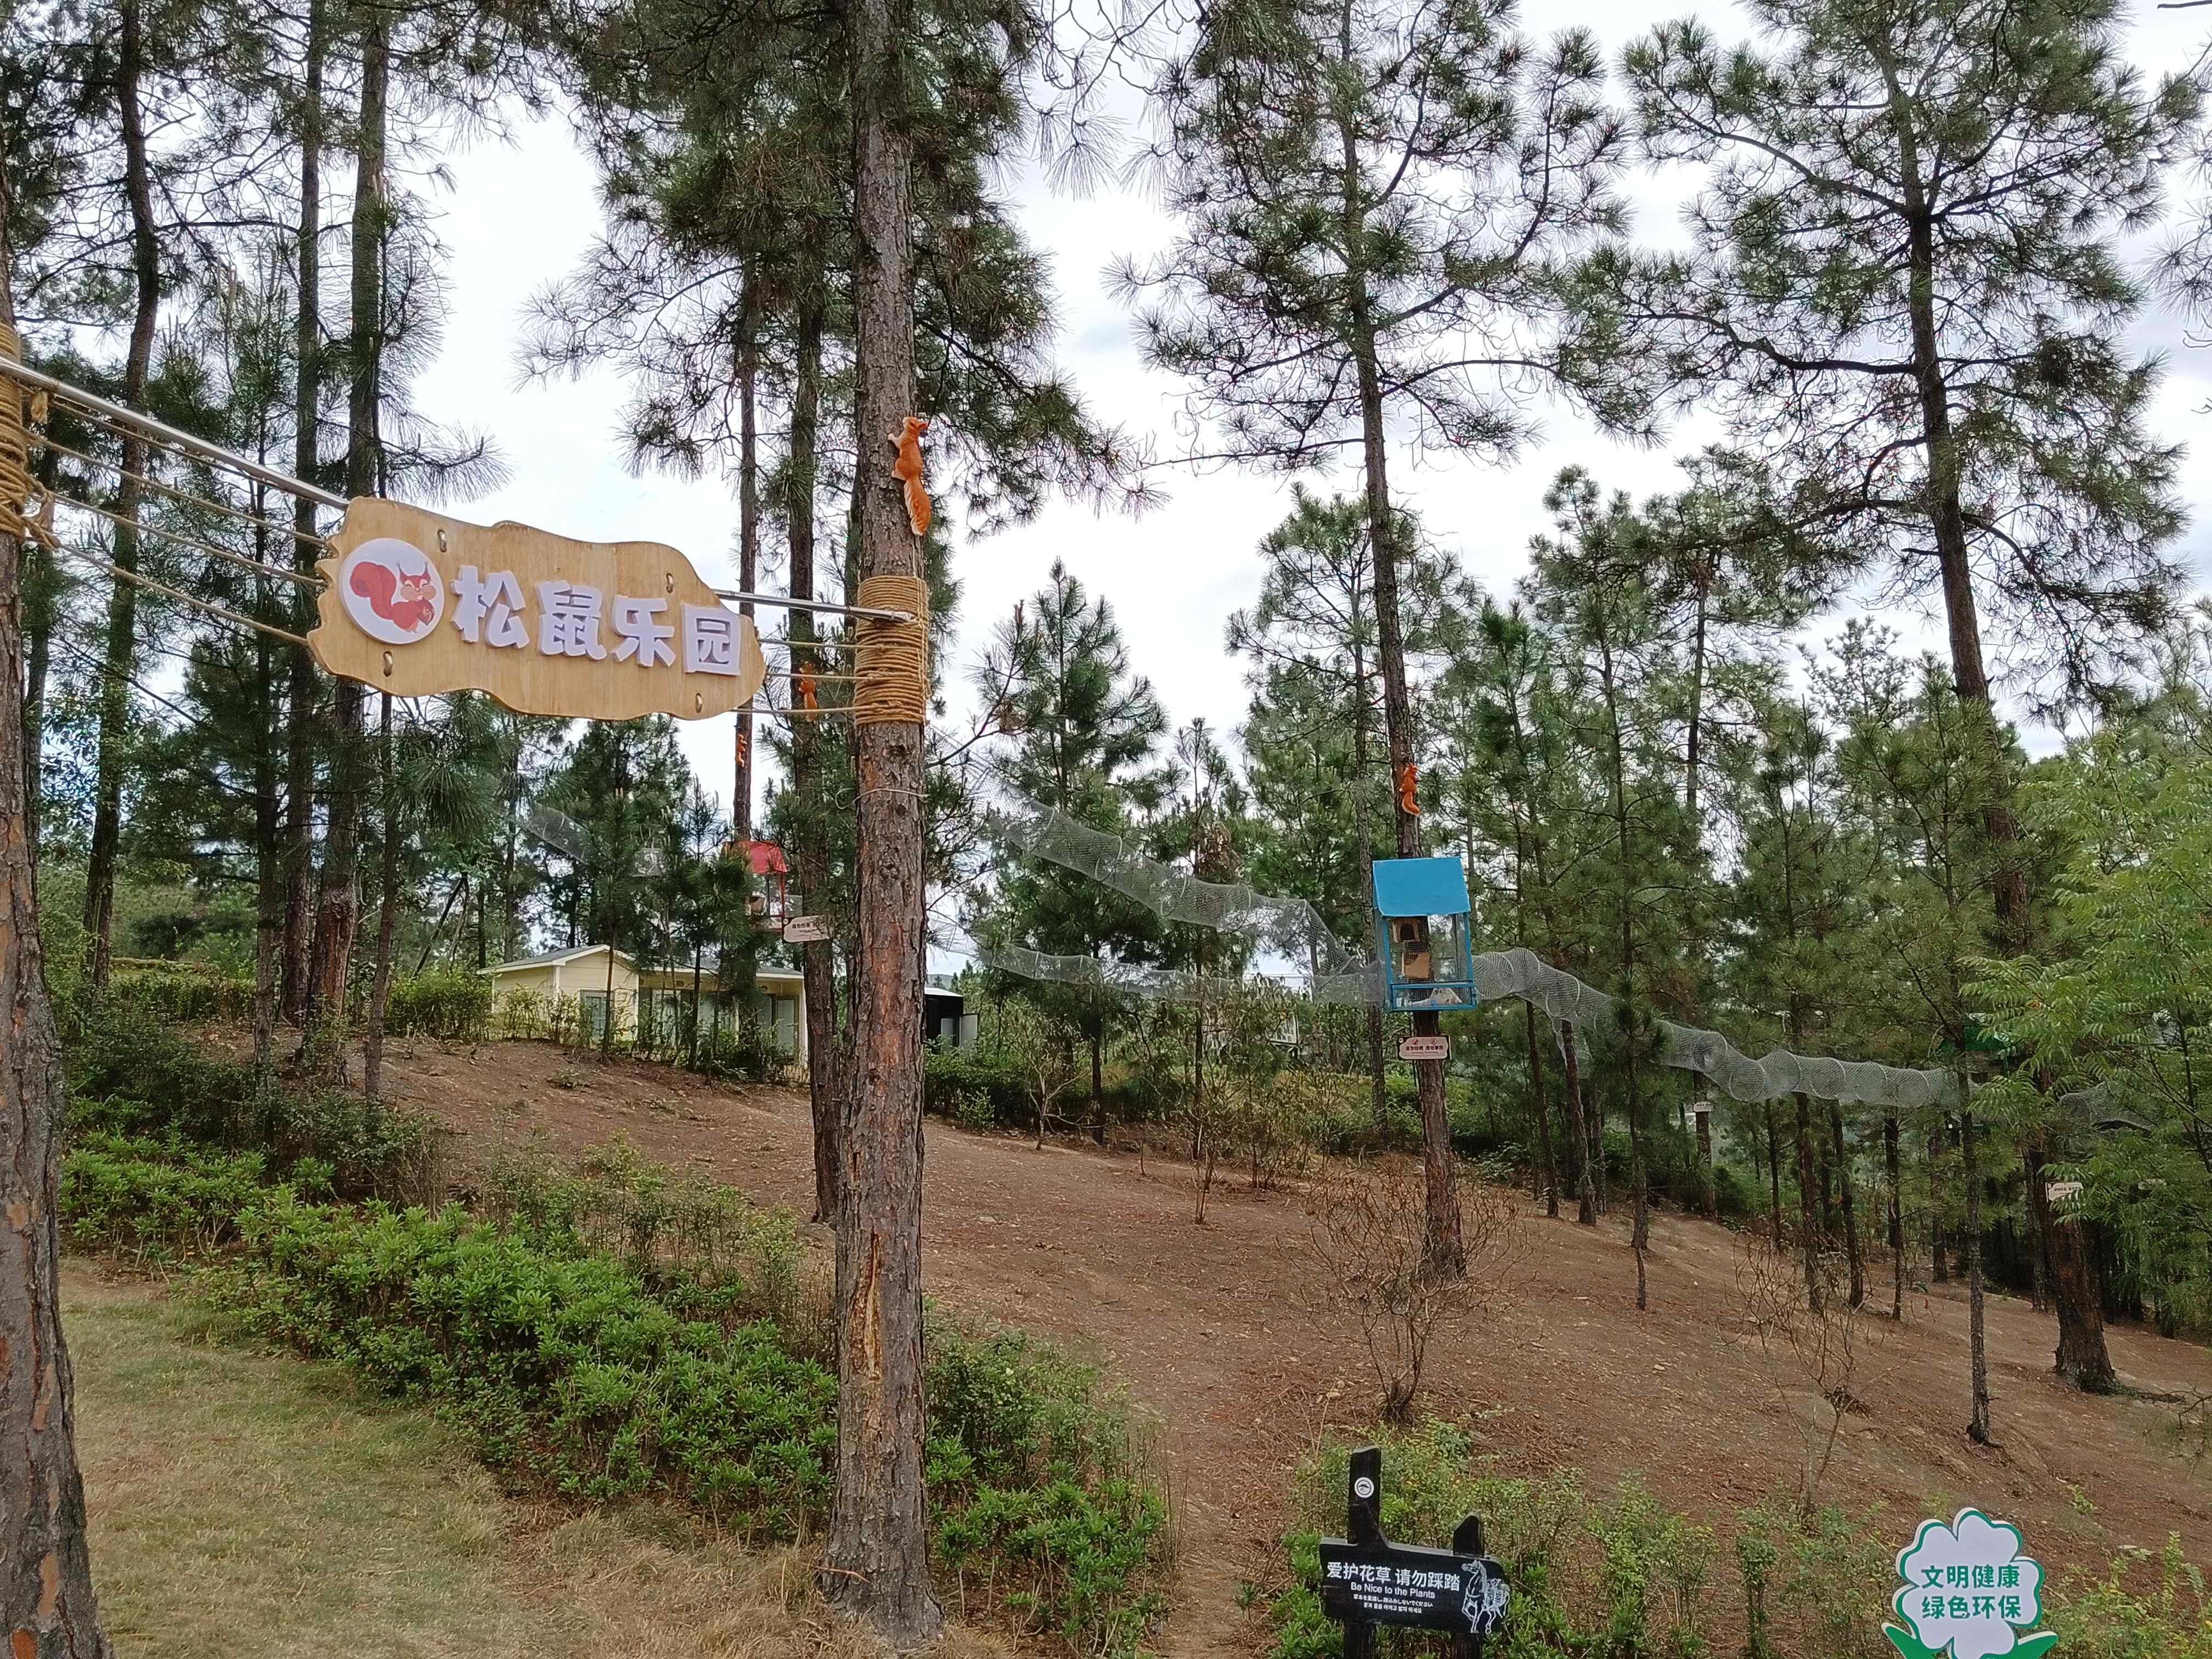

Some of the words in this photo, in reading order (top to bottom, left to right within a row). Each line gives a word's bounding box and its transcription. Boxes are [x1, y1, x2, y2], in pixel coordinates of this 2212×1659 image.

[451, 565, 741, 676] 松鼠乐园
[1327, 1562, 1391, 1584] 爱护花草
[1395, 1568, 1460, 1591] 请勿踩踏
[1921, 1564, 2020, 1589] 文明健康
[1351, 1582, 1362, 1591] Be
[1364, 1583, 1382, 1593] Nice
[1385, 1585, 1392, 1594] to
[1395, 1587, 1407, 1595] the
[1410, 1588, 1435, 1599] Plants
[1922, 1595, 2022, 1619] 绿色环保
